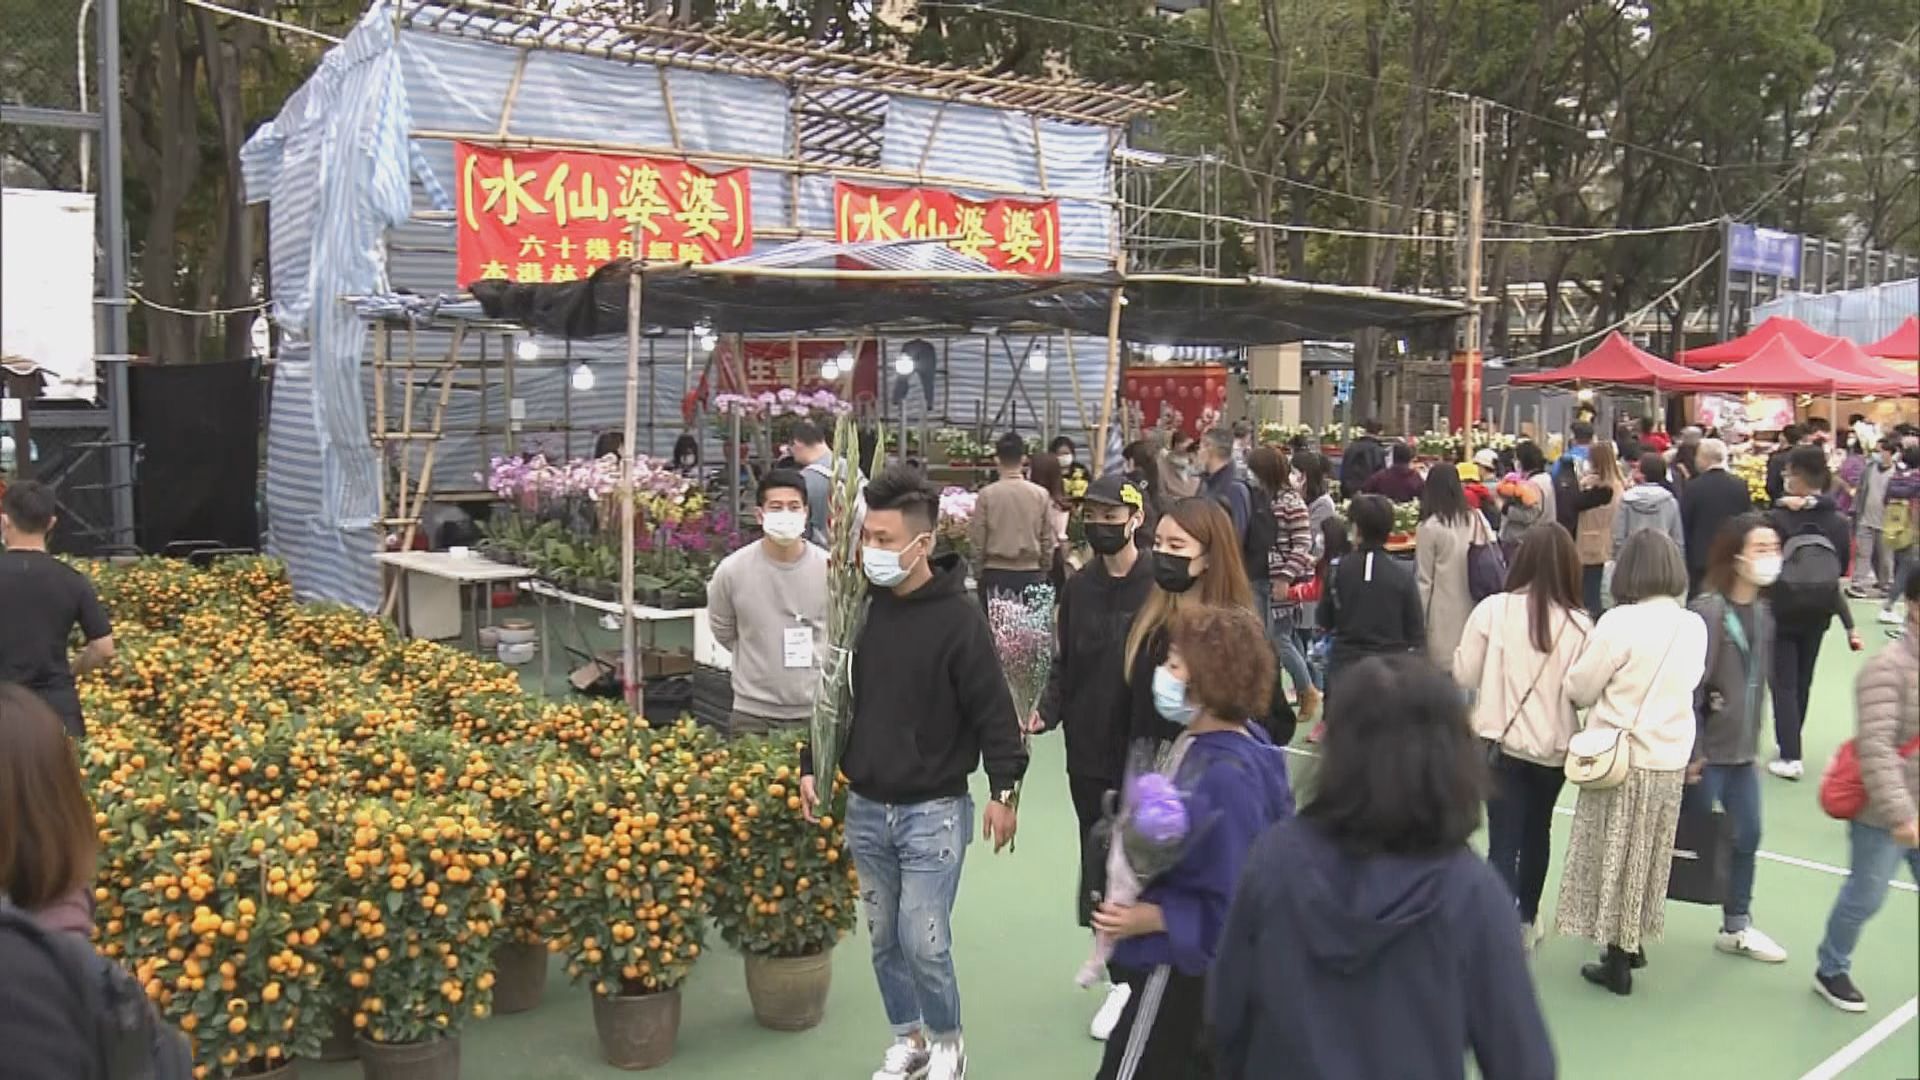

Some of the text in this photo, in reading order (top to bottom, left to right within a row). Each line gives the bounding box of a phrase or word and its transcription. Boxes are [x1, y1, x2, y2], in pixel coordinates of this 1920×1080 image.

[463, 153, 745, 248] (水仙婆婆)
[840, 191, 1055, 269] (水仙婆婆)
